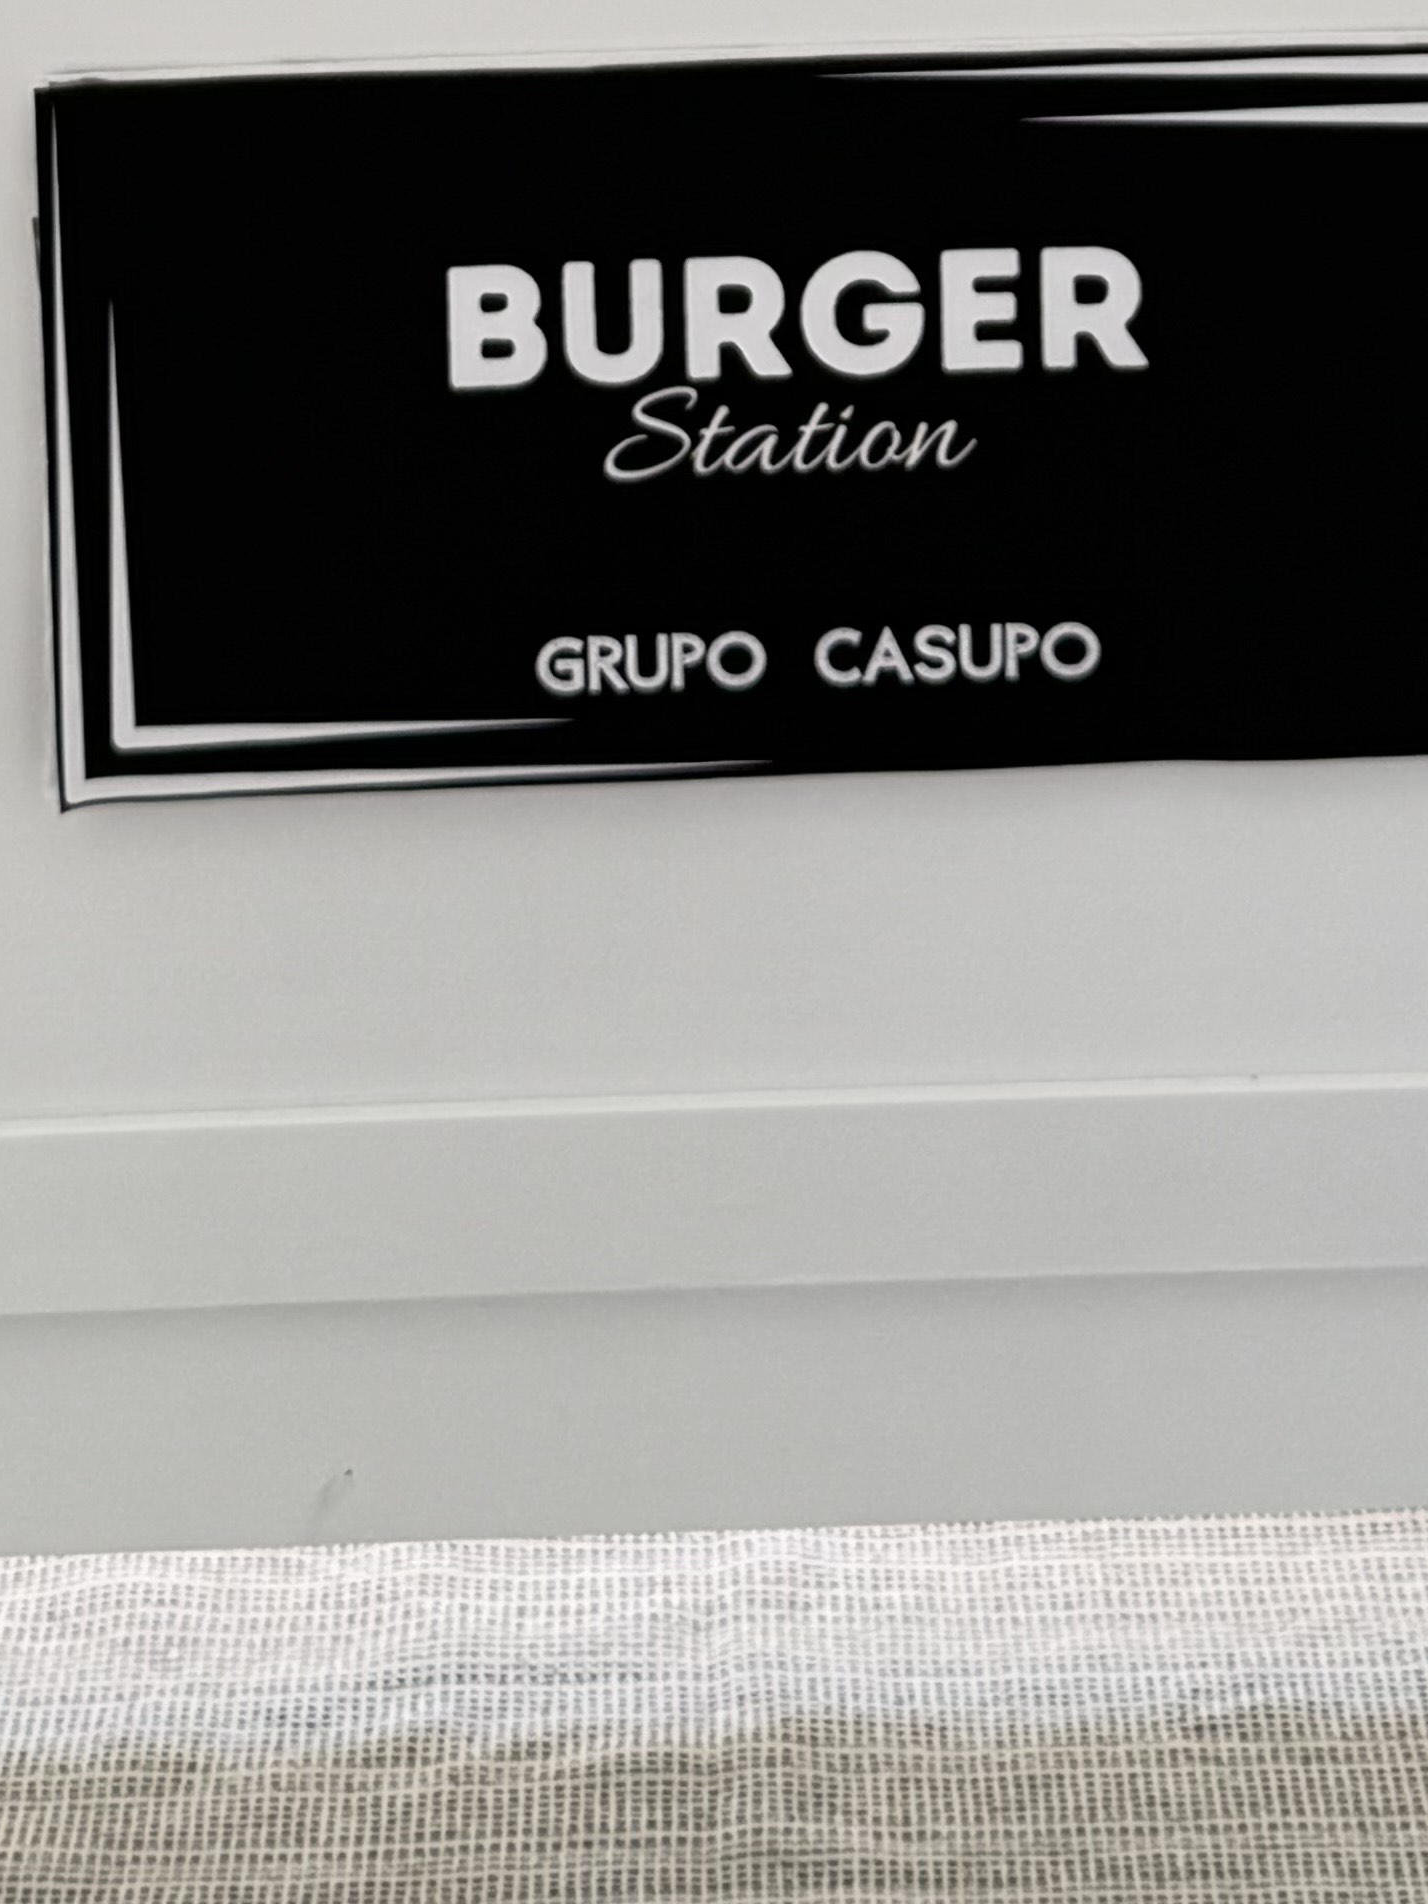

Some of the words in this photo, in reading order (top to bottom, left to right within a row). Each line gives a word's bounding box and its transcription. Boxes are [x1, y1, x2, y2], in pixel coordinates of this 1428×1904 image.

[446, 246, 1150, 391] BURGER
[602, 386, 978, 482] Station
[535, 630, 768, 695] GRUPO
[813, 621, 1102, 686] CASUPO
